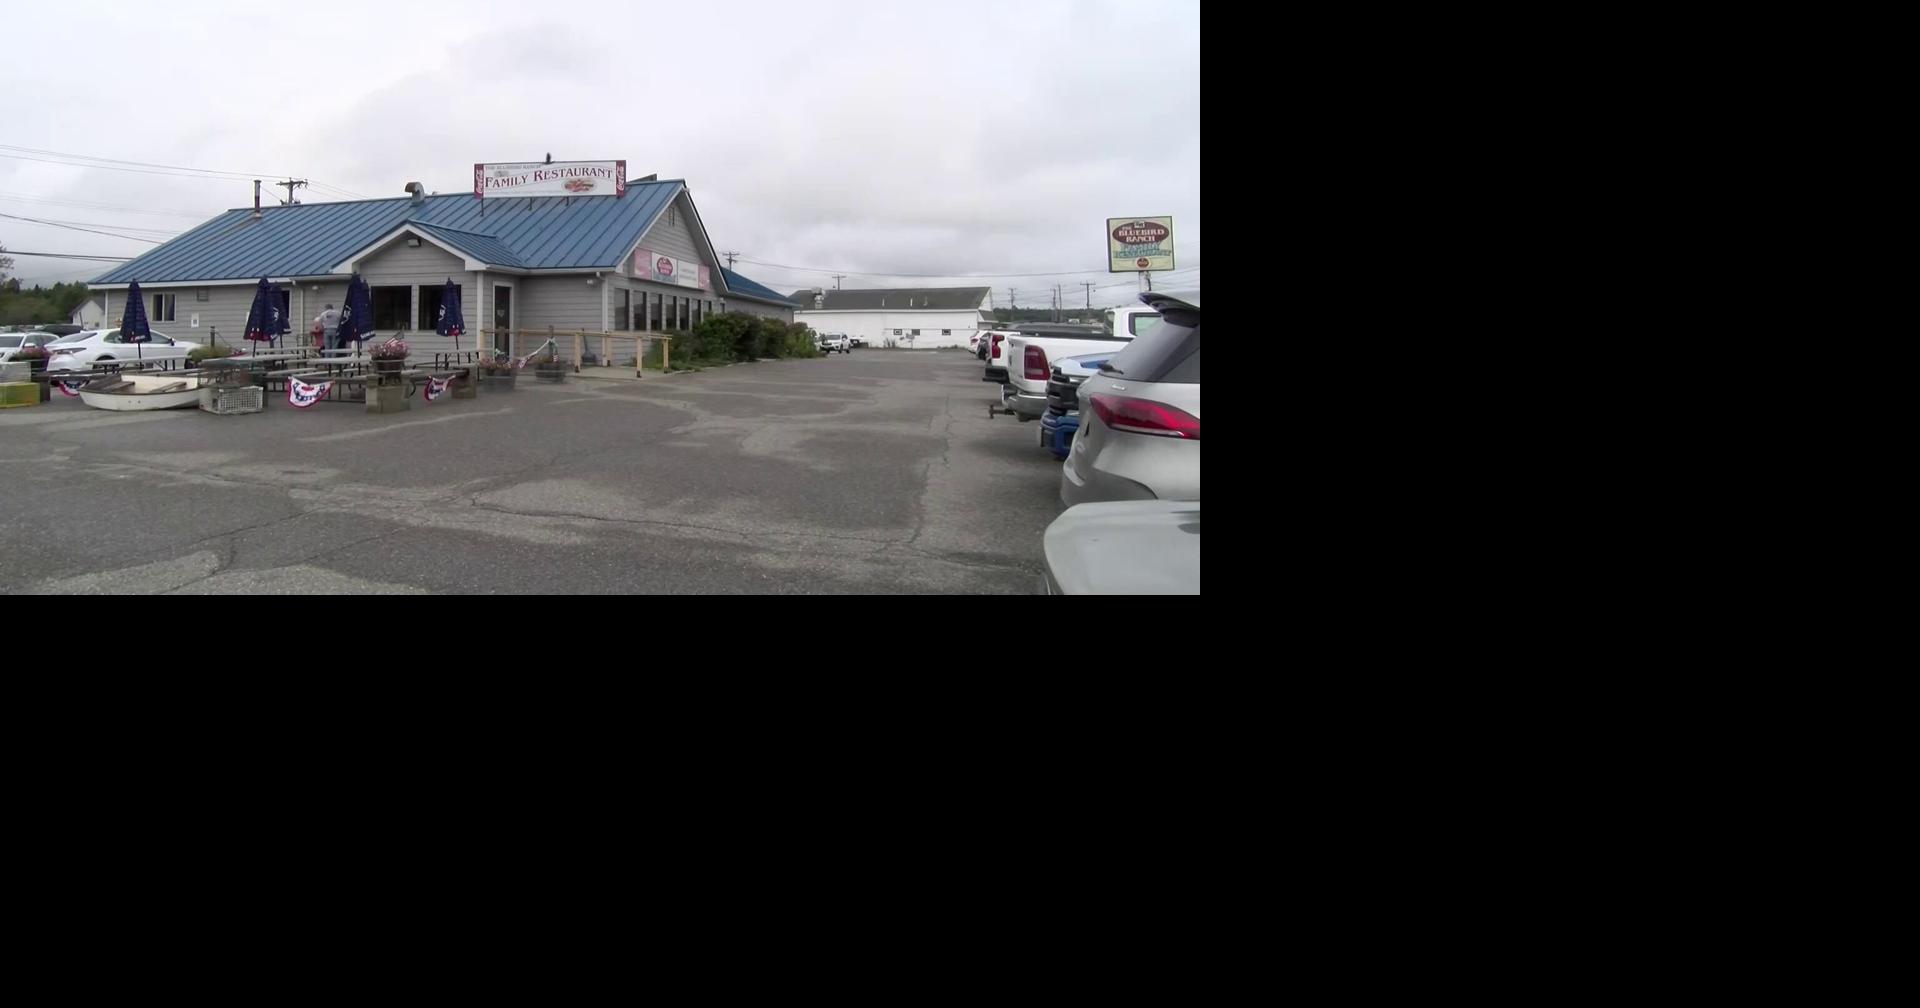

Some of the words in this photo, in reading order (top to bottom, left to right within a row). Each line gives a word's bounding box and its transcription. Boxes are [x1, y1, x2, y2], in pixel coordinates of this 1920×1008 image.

[485, 175, 528, 188] FAMILY
[534, 167, 613, 182] RESTAURANT
[1118, 228, 1165, 237] BLUEBIRD
